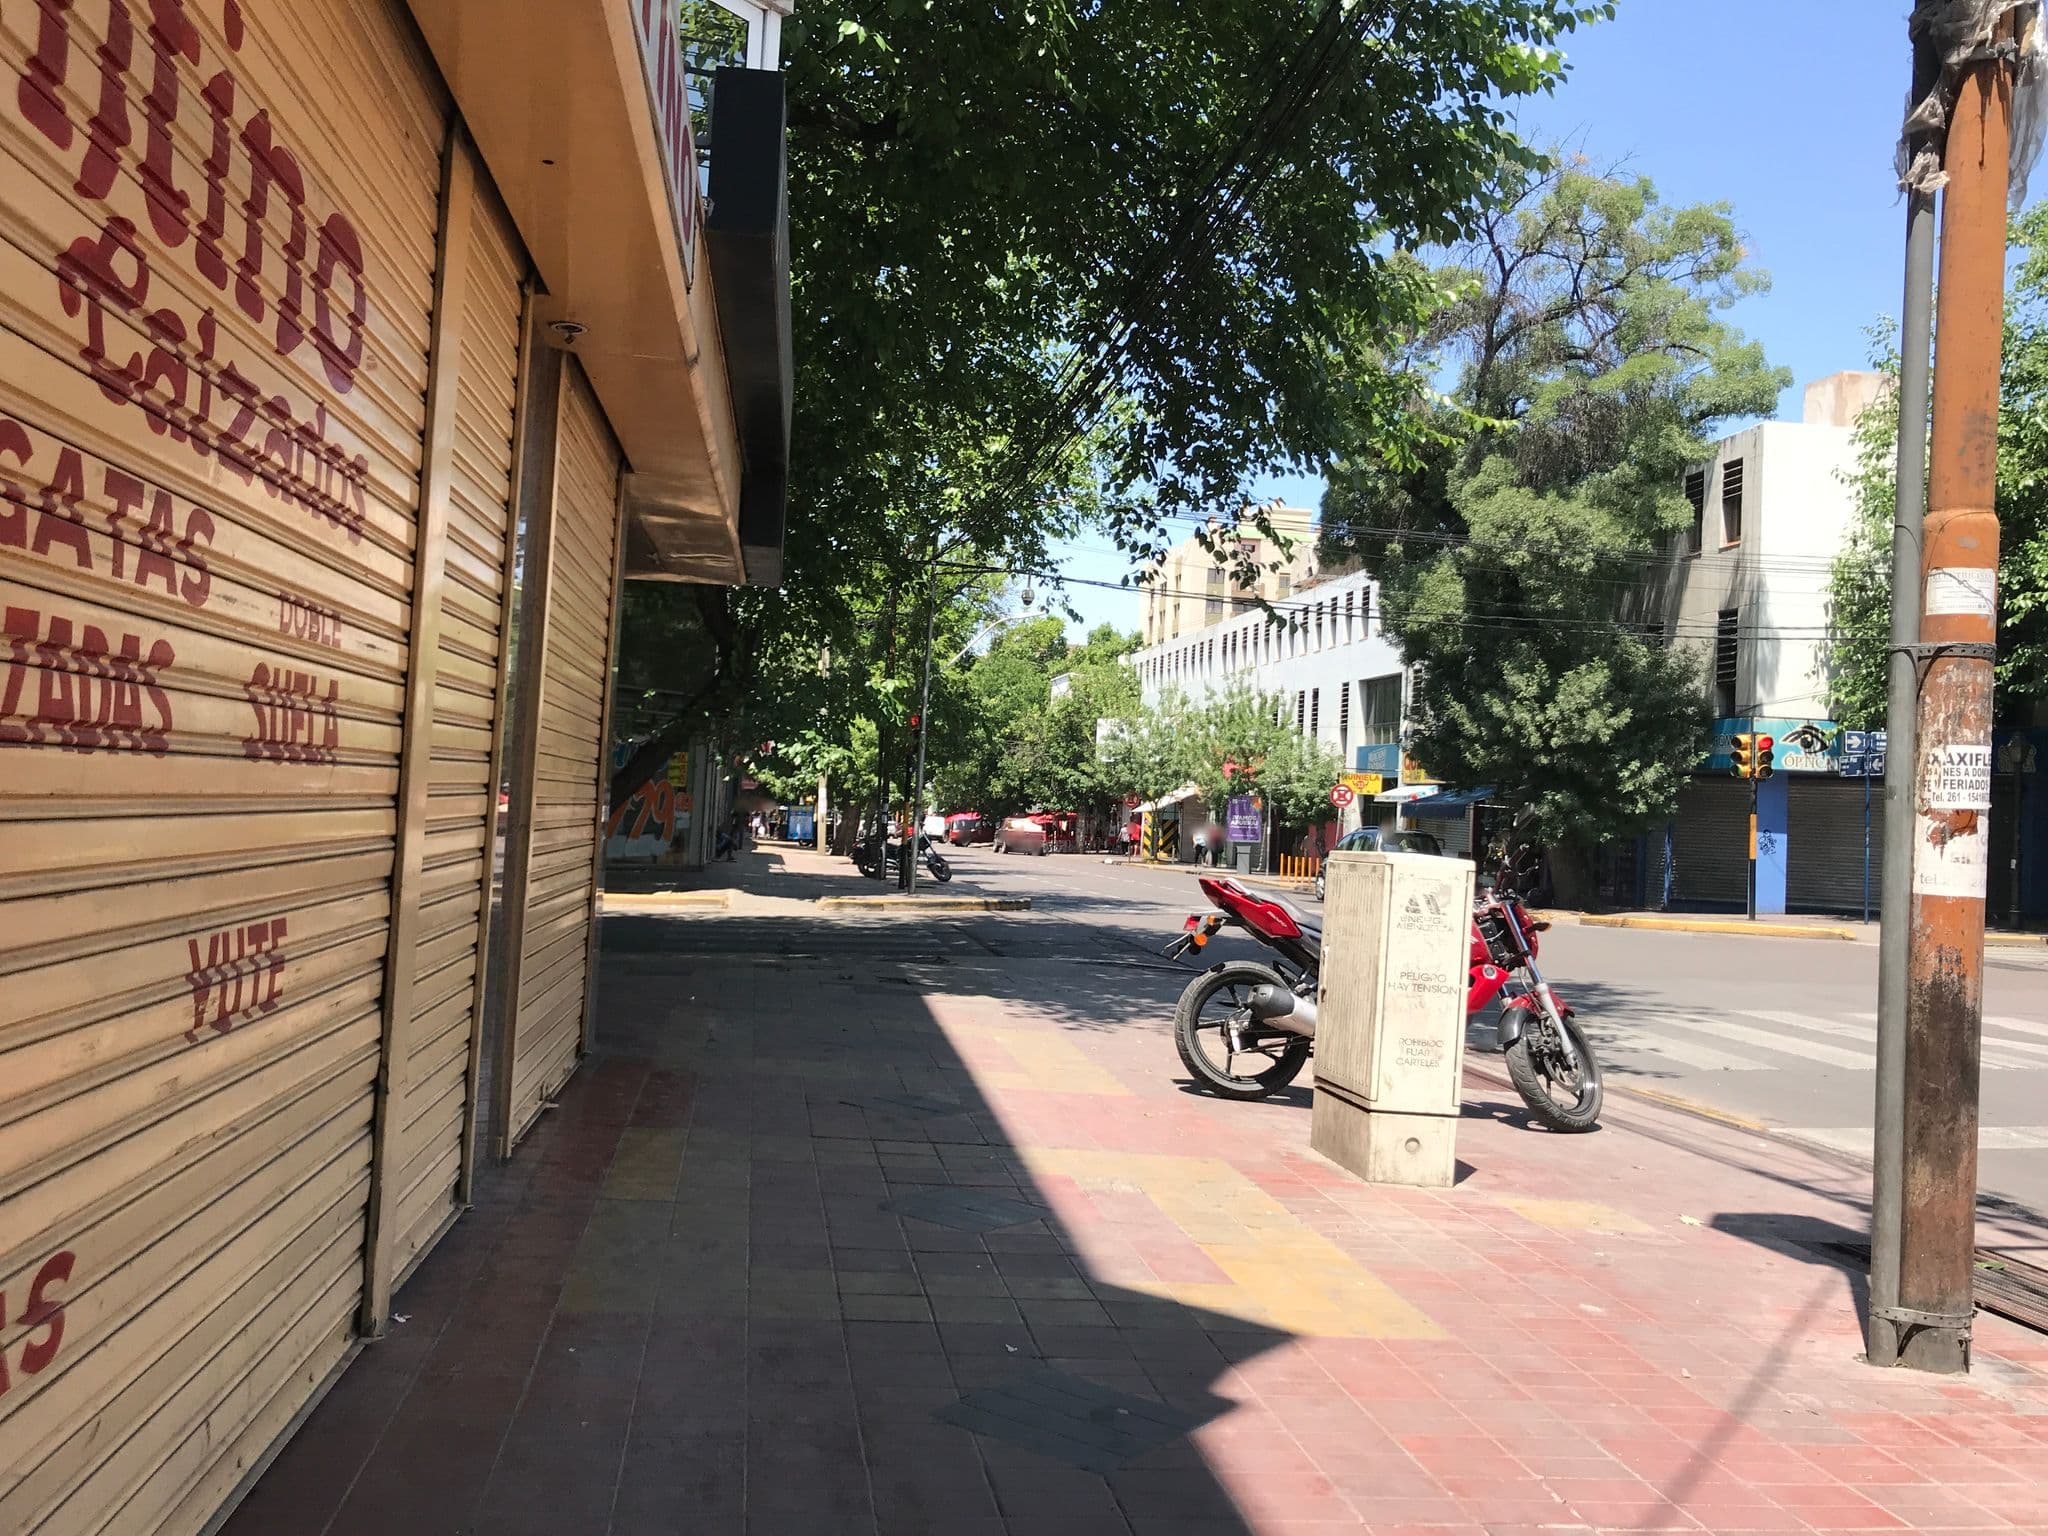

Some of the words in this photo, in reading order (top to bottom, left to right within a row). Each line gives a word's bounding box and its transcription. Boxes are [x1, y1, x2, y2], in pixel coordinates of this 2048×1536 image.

[279, 592, 343, 648] DOBLE
[243, 662, 340, 764] SUELA
[1399, 971, 1447, 983] PELIGRO
[1388, 981, 1409, 991] HAY
[1395, 1057, 1440, 1068] CARTELES
